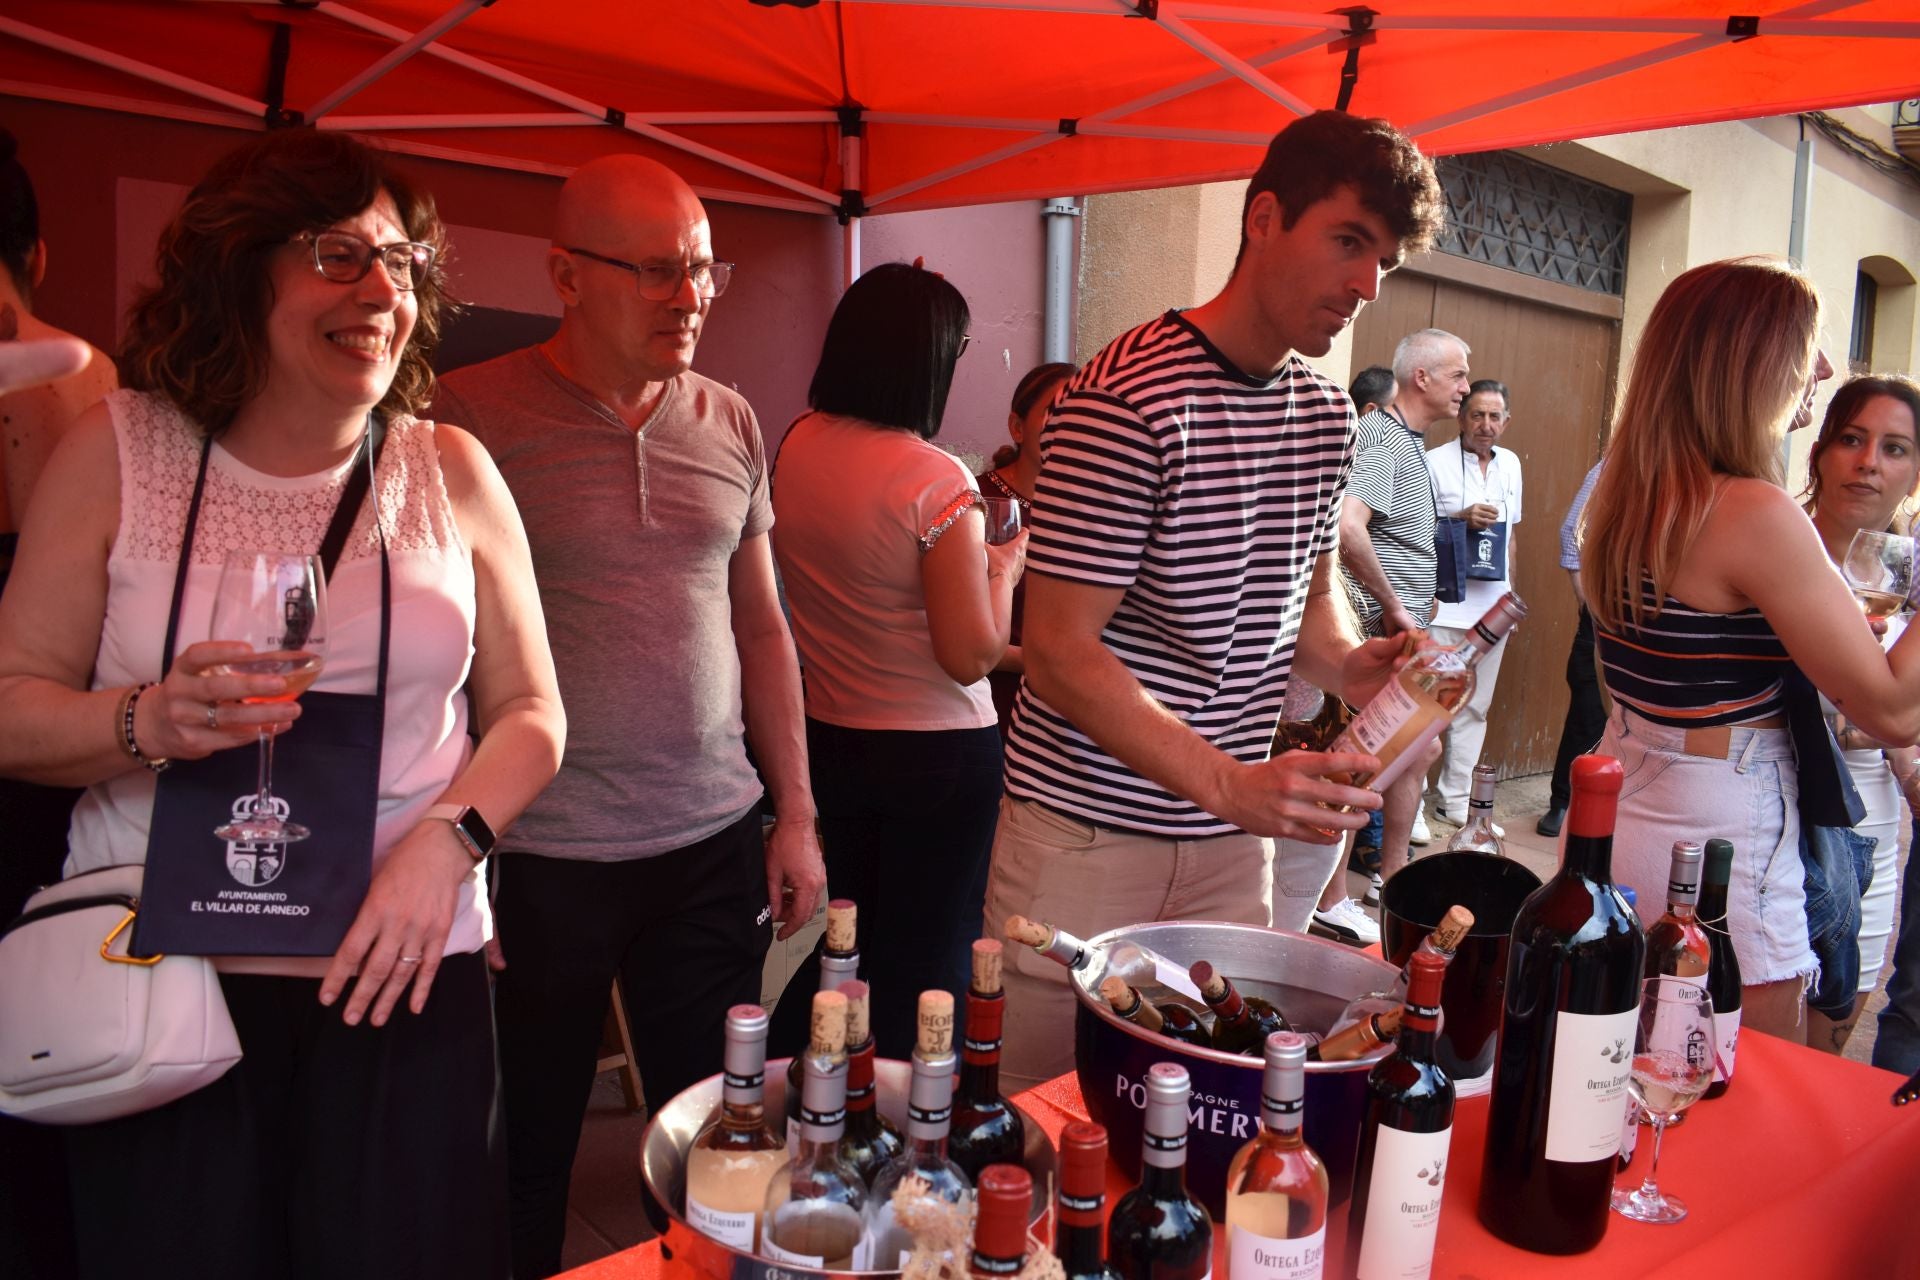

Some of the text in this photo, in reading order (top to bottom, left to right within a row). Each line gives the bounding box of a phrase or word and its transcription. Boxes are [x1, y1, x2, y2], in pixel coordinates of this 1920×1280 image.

[218, 890, 287, 901] AYUNTAMIENTO
[191, 901, 310, 916] EL VILLAR DE ARNEDO
[1588, 1080, 1611, 1089] ORTEGA
[1116, 1074, 1262, 1139] POMER
[1401, 1202, 1428, 1214] ORTEGA
[1255, 1248, 1299, 1268] ORTEGA
